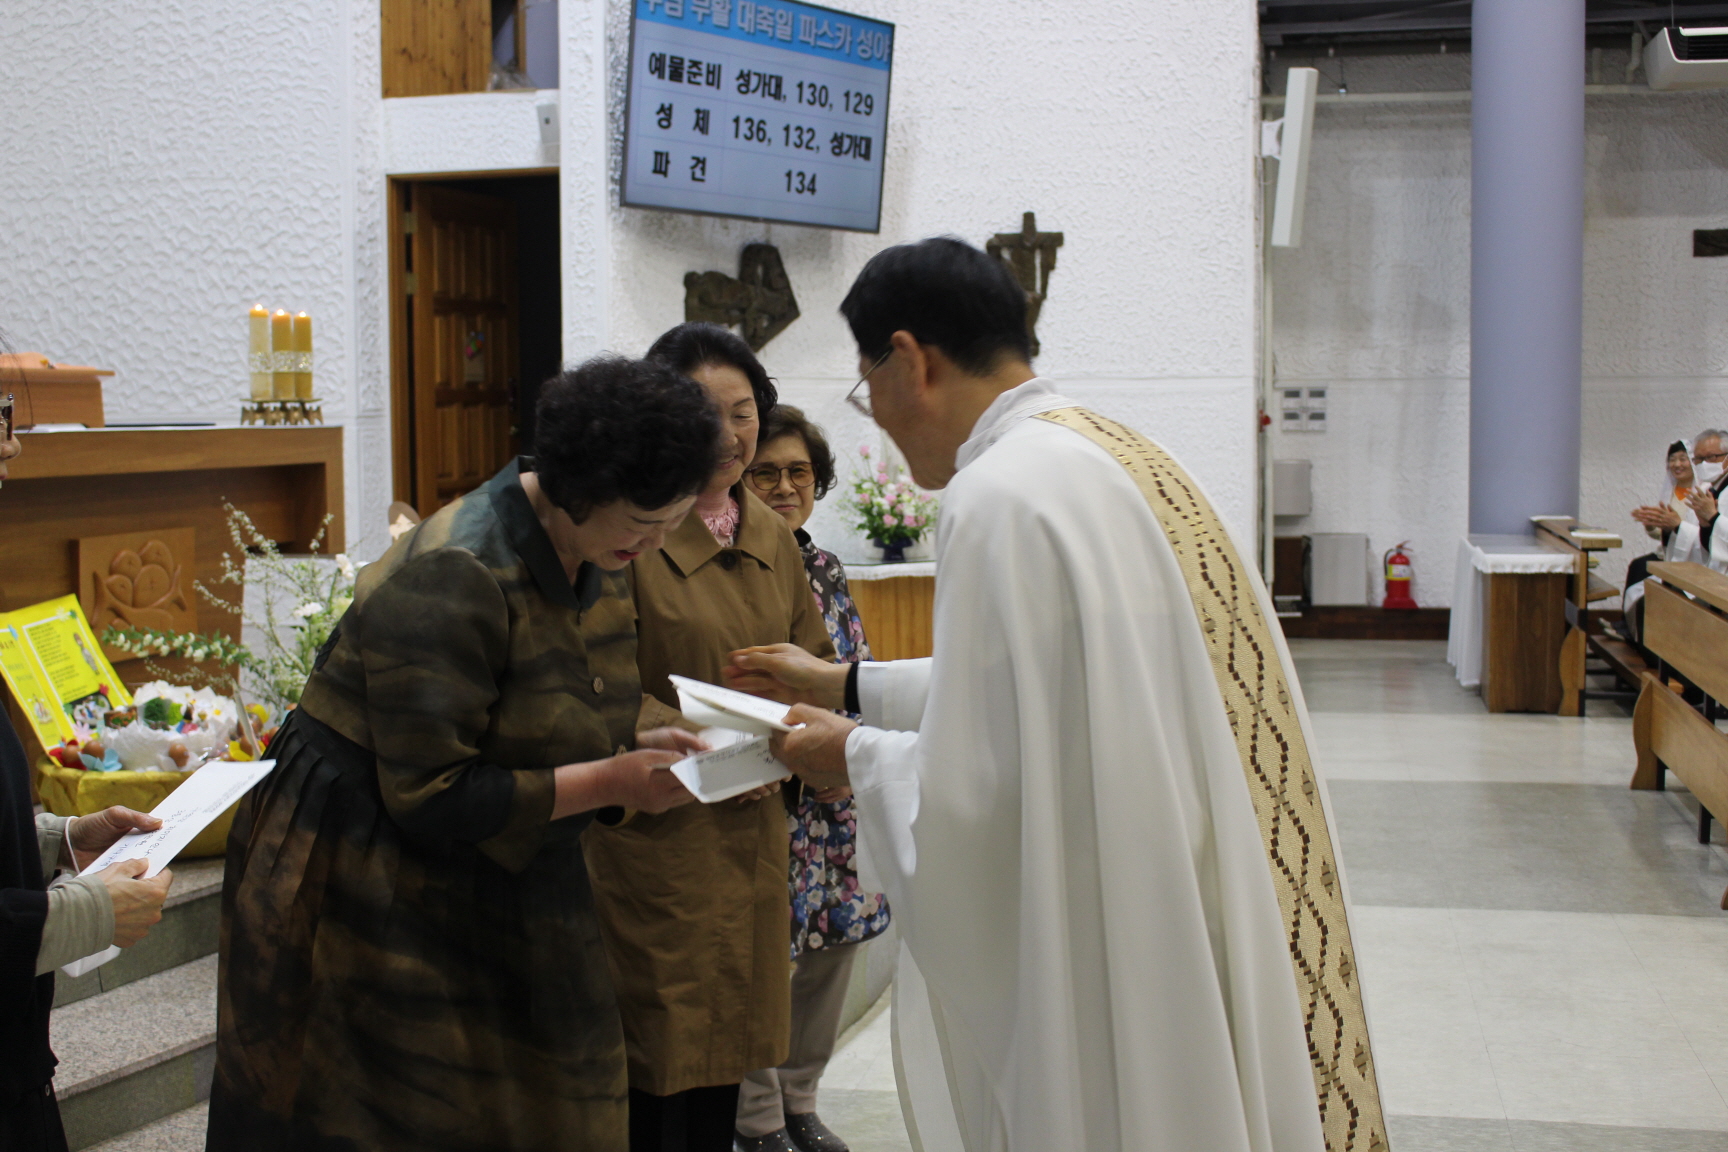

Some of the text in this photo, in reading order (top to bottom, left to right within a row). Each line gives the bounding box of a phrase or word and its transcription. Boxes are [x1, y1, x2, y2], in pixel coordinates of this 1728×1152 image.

[691, 0, 731, 28] 부활
[737, 1, 793, 41] 대축일
[797, 13, 852, 55] 파스카
[856, 28, 891, 63] 성야
[648, 52, 875, 117] 예물준비 성가대, 130, 129
[655, 103, 673, 130] 성
[732, 115, 773, 144] 136,
[783, 123, 820, 151] 132,
[829, 131, 874, 162] 성가대
[651, 150, 818, 196] 파 견 134
